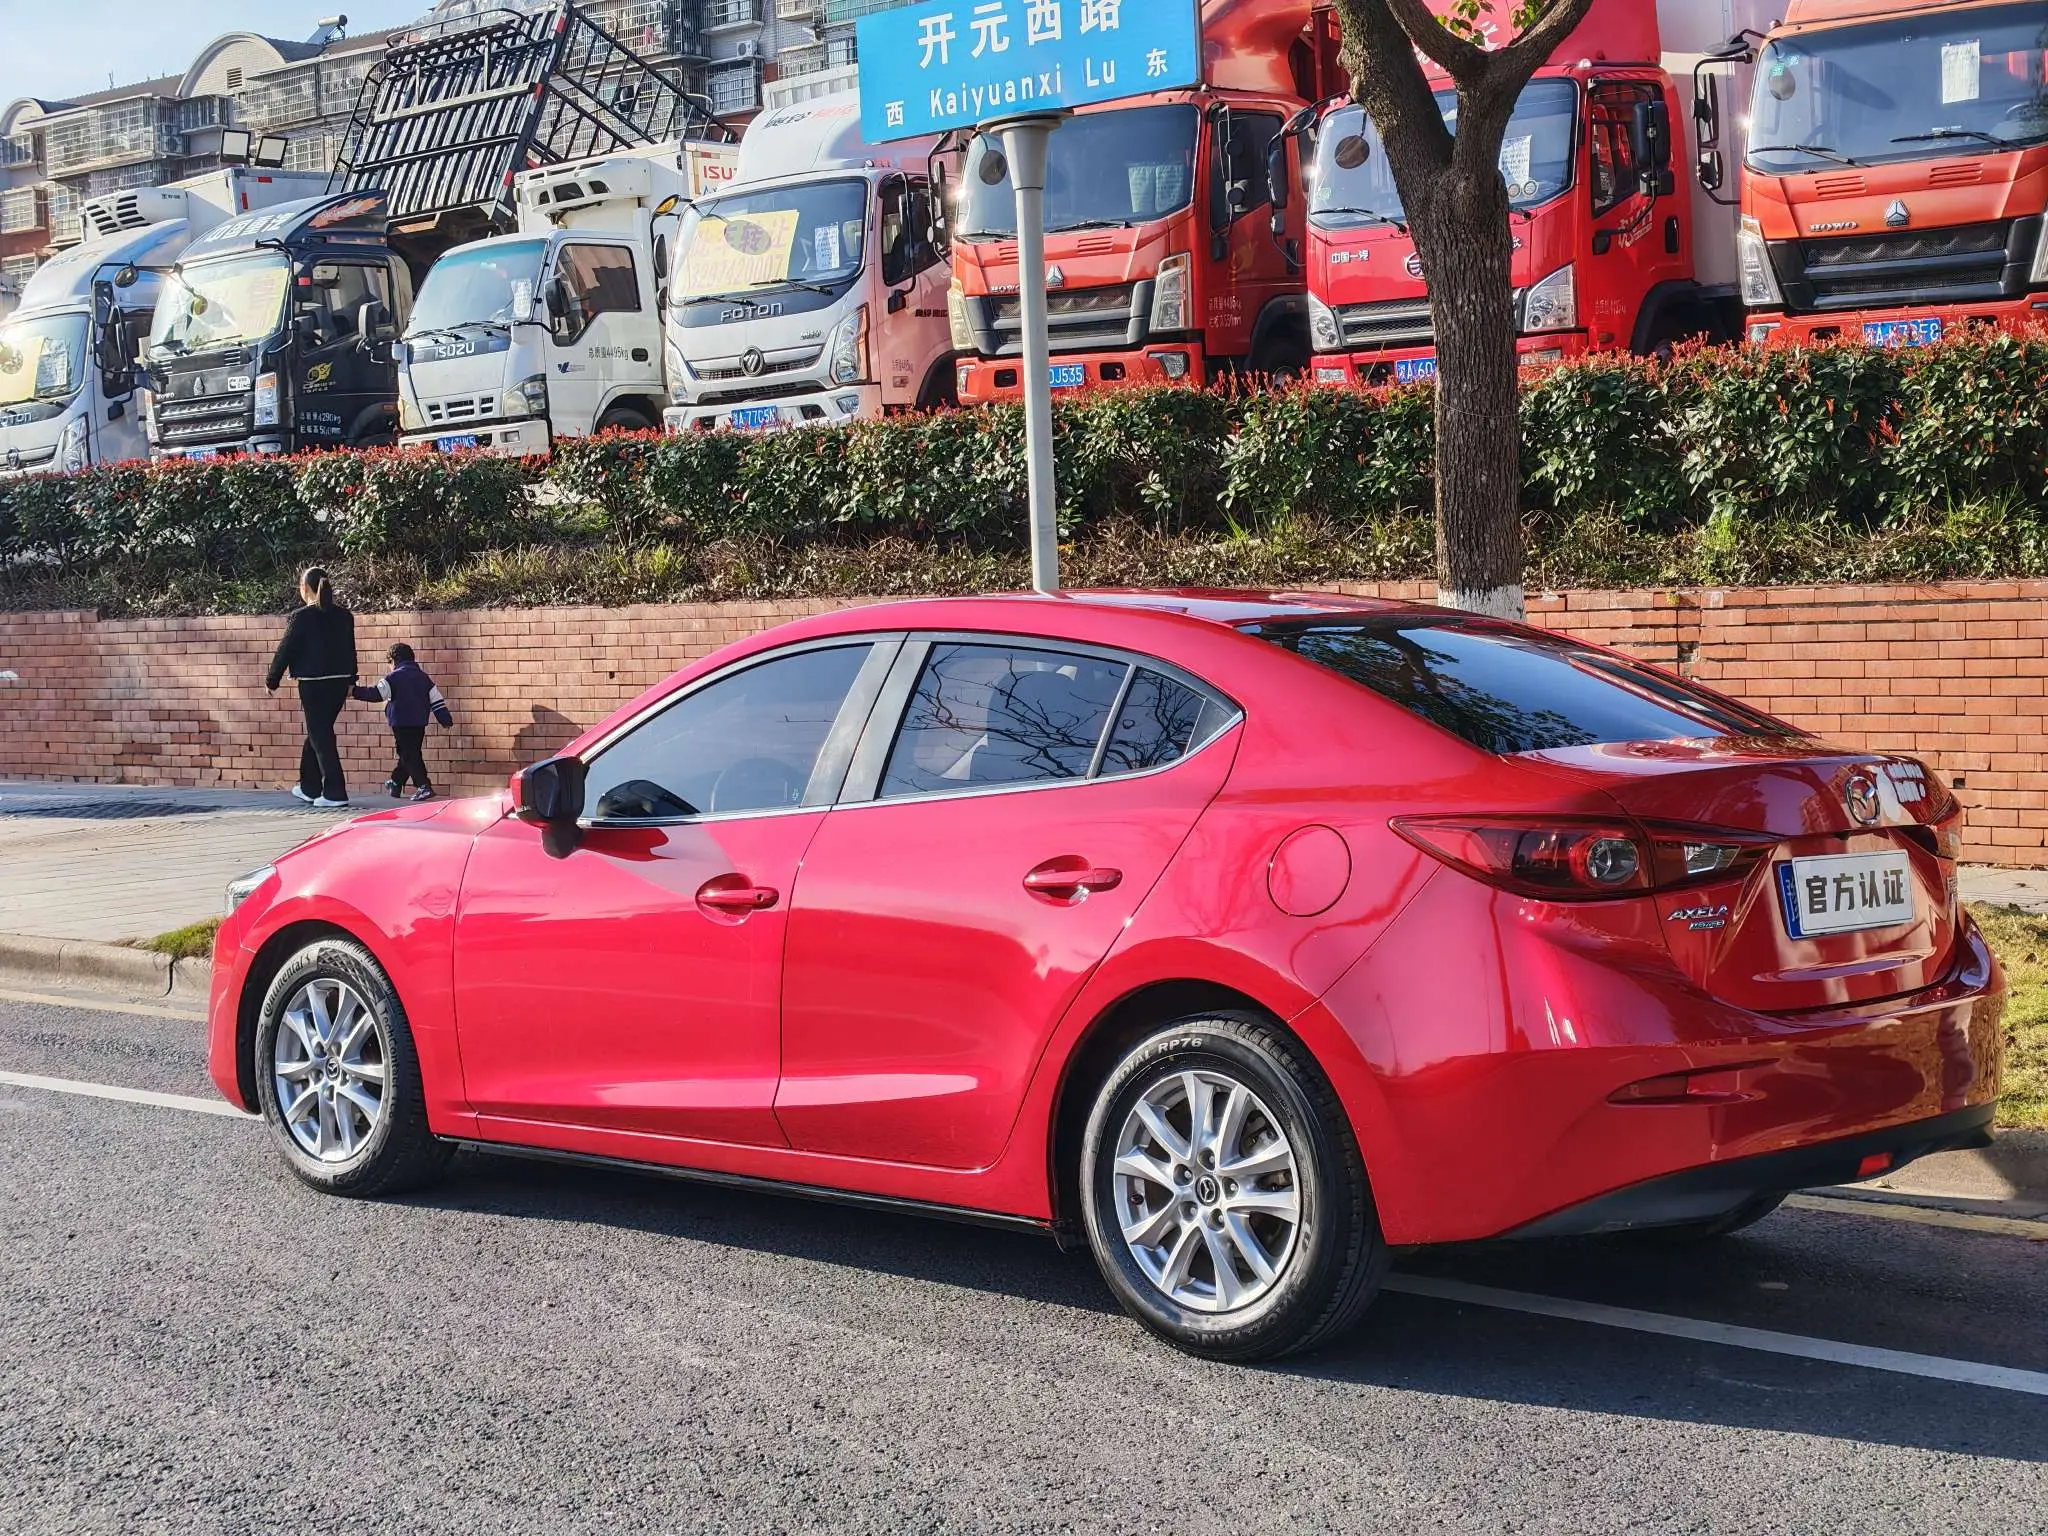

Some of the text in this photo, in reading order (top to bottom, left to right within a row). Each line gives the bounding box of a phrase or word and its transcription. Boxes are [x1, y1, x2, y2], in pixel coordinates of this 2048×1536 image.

[918, 0, 1121, 69] 开元西路
[1146, 48, 1168, 78] 东
[930, 57, 1116, 118] Kaiyuanxi Lu
[885, 100, 904, 127] 西
[703, 165, 737, 180] ISU
[720, 302, 784, 323] FOTON
[1806, 869, 1905, 915] 官方认证
[1667, 904, 1728, 920] AXELA
[263, 955, 304, 1018] Continental
[1157, 1037, 1203, 1055] RP76
